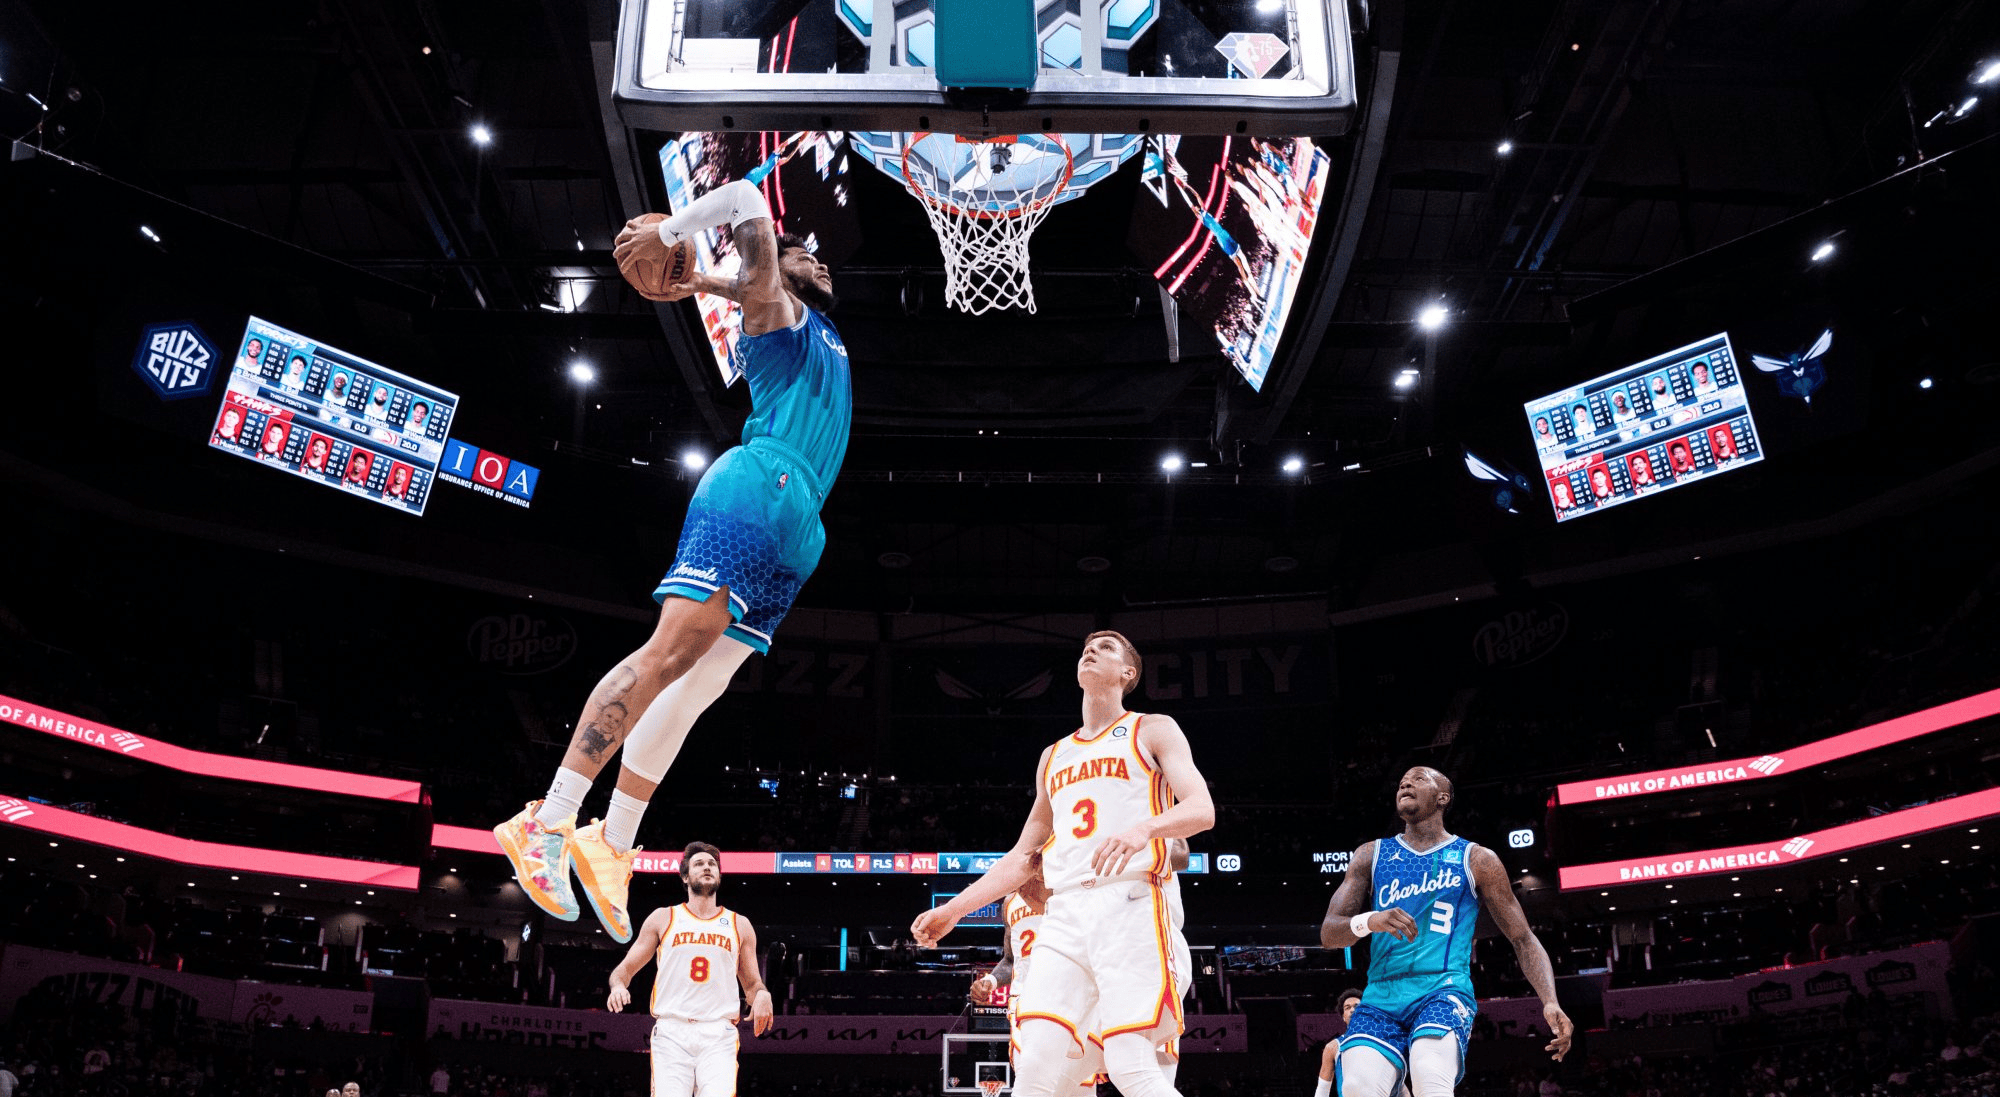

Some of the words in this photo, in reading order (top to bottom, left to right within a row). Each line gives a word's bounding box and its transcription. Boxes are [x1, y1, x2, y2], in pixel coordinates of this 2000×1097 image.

[150, 330, 210, 369] BUZZ
[147, 352, 200, 388] CITY
[1702, 401, 1719, 412] 20.0
[353, 422, 367, 432] 0.0
[1653, 418, 1667, 429] 0.0
[401, 439, 417, 451] 20.0
[438, 472, 472, 489] INSURANCE
[474, 483, 494, 496] OFFICE
[495, 490, 504, 498] OF
[504, 492, 530, 508] AMERICA
[674, 561, 718, 581] Hornets
[510, 613, 547, 639] Dr
[1504, 608, 1538, 637] Dr
[467, 616, 571, 667] Pepper
[1473, 612, 1563, 667] Pepper
[727, 649, 866, 697] UZZ
[1144, 645, 1300, 700] CITY
[0, 705, 23, 720] OF
[25, 713, 105, 745] AMERICA
[1050, 757, 1131, 800] ATLANTA
[1596, 779, 1641, 798] BANK
[1644, 777, 1665, 791] OF
[1669, 766, 1747, 789] AMERICA
[1072, 798, 1097, 839] 3
[1512, 832, 1531, 846] CC
[633, 858, 680, 870] ERICA
[782, 859, 812, 868] Assists
[833, 858, 854, 869] TOL
[857, 858, 865, 869] 7
[873, 858, 892, 869] FLS
[896, 858, 904, 869] 4
[911, 857, 936, 869] ATL
[946, 858, 960, 869] 14
[975, 858, 1001, 869] 4:2
[1220, 858, 1238, 869] CC
[1313, 853, 1324, 862] IN
[1326, 852, 1348, 862] FOR
[1620, 862, 1668, 880] BANK
[1671, 859, 1694, 874] OF
[1698, 850, 1780, 872] AMERICA
[1378, 868, 1462, 908] Charlotte
[1010, 906, 1037, 927] ATL
[1430, 900, 1455, 935] 3
[672, 932, 732, 953] ATLANTA
[690, 956, 711, 984] 8
[490, 1015, 583, 1031] CHARLOTTE
